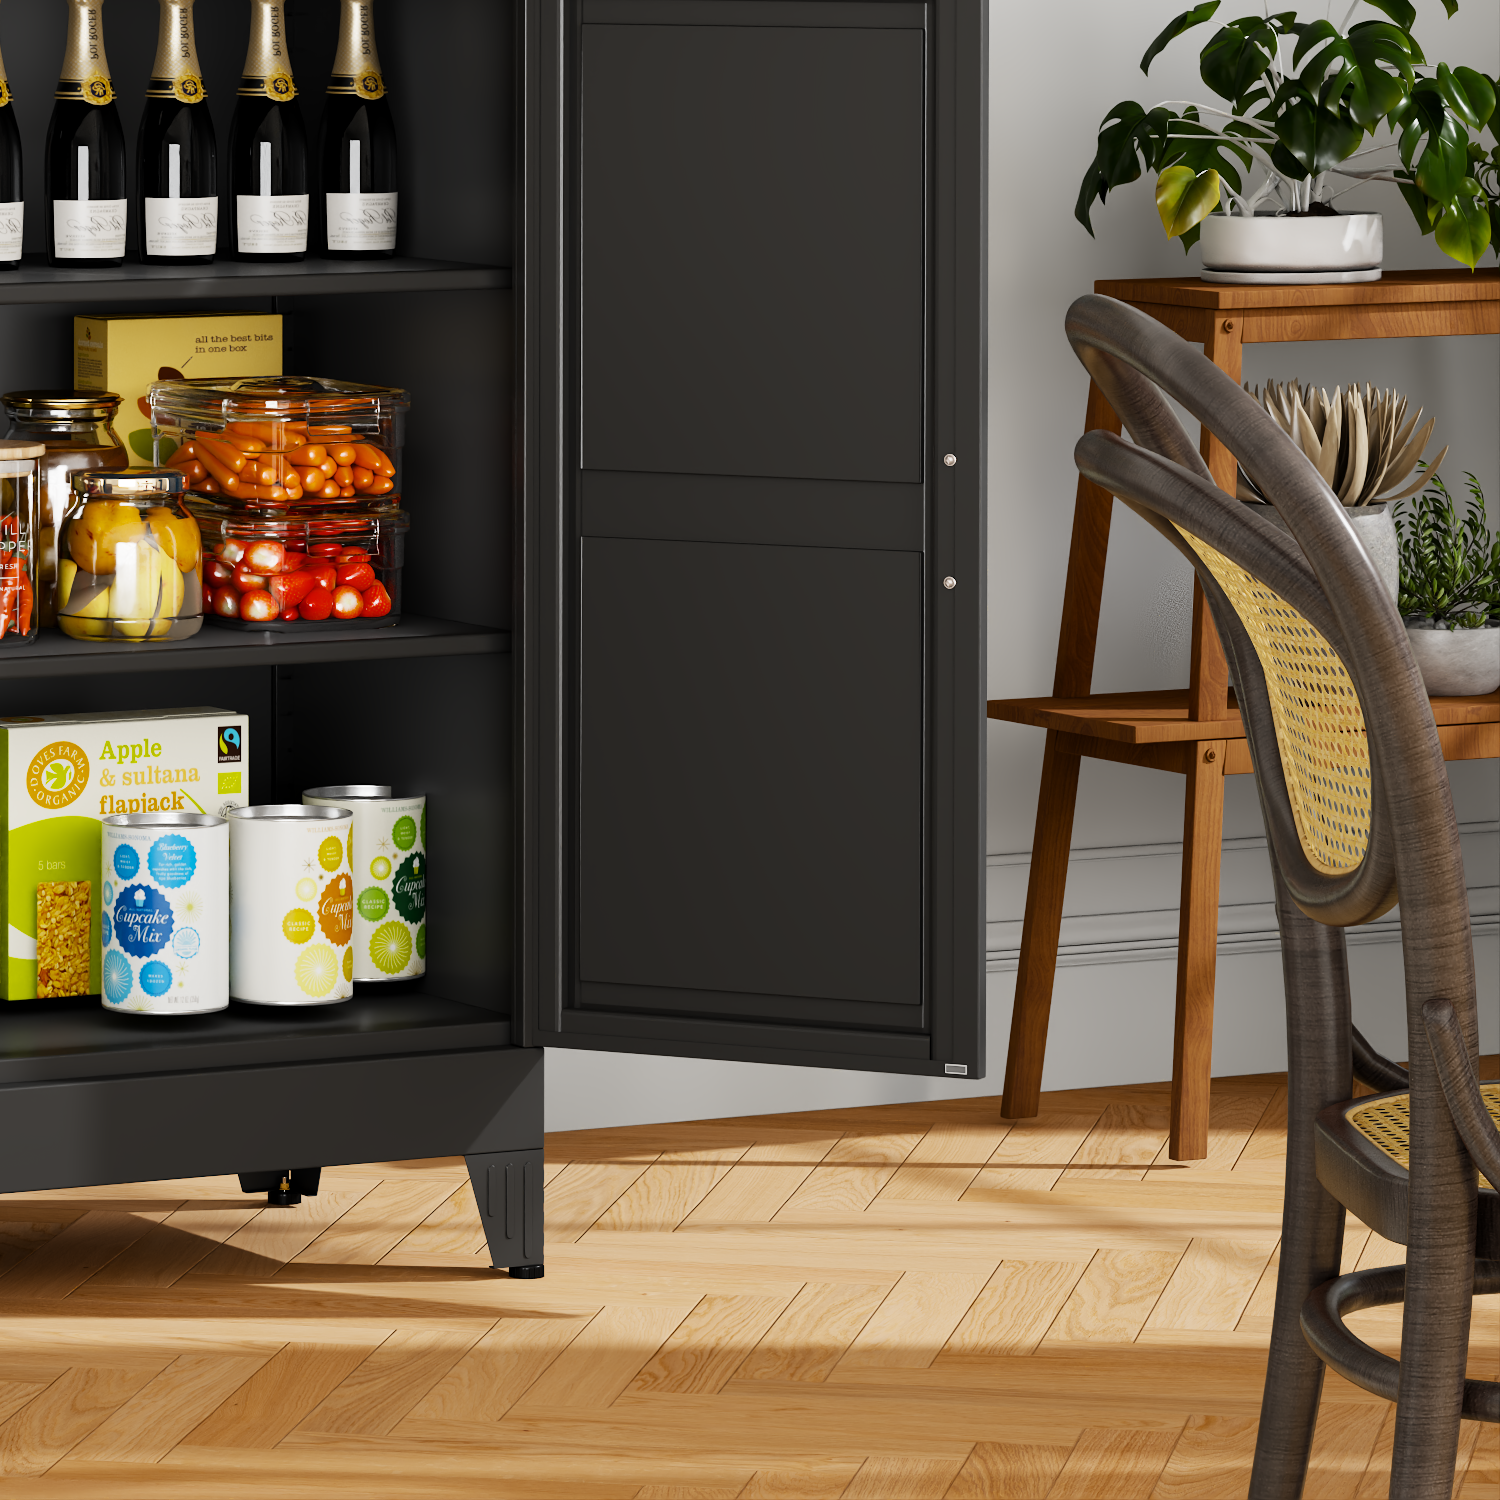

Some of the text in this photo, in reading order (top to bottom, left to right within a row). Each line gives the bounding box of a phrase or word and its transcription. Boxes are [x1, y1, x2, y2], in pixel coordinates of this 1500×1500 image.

[195, 334, 274, 344] all the best bits
[195, 344, 248, 354] in one box
[99, 738, 162, 765] Apple
[30, 747, 56, 788] DOVES
[58, 745, 85, 770] FARM
[99, 765, 201, 788] & sultana
[36, 774, 85, 806] ORGANIC
[99, 791, 185, 815] flapjack
[37, 859, 66, 871] 5 bars
[116, 904, 170, 928] Cupcake
[127, 924, 163, 943] Mix
